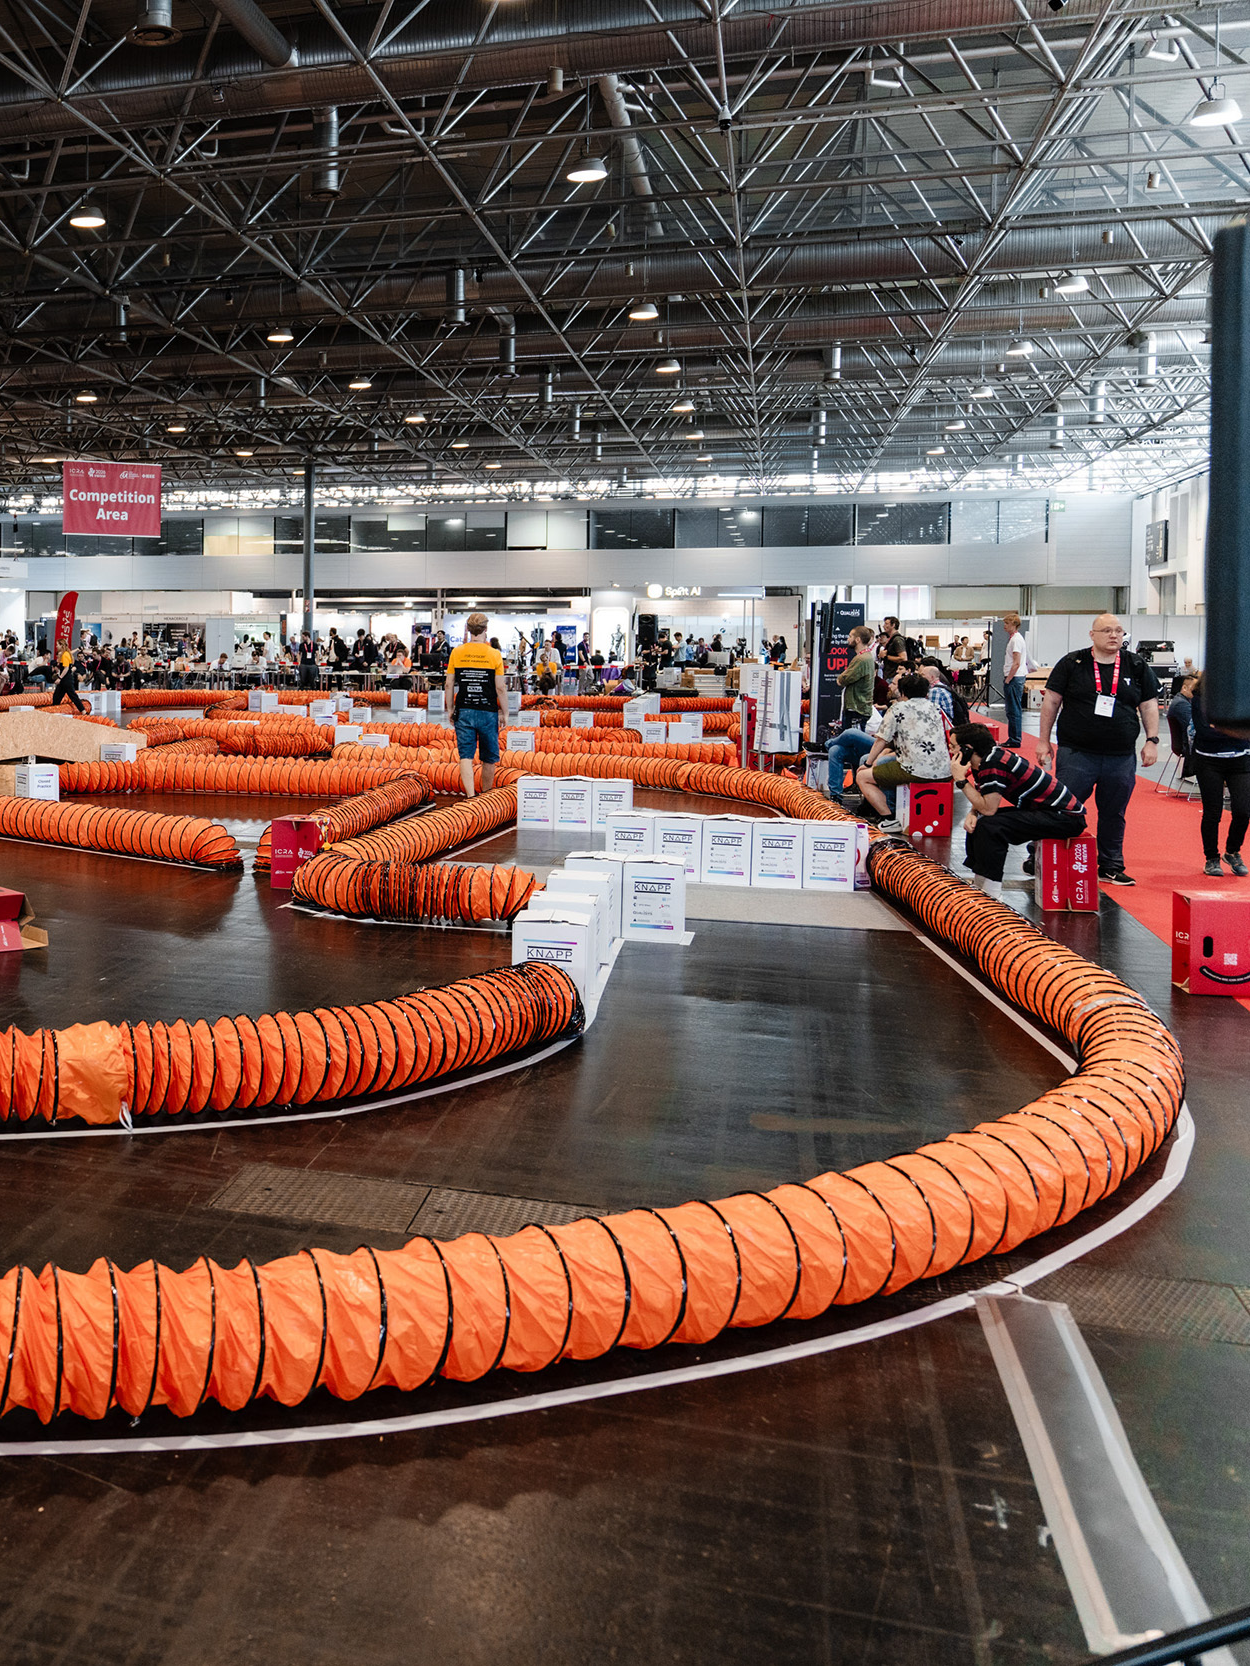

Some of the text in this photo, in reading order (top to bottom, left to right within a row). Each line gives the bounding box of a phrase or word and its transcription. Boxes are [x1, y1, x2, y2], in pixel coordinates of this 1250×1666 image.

[69, 488, 156, 506] Competition
[95, 507, 129, 521] Area
[690, 586, 701, 596] AI
[827, 658, 849, 671] UP!
[614, 831, 644, 840] KNAPP
[662, 834, 693, 842] KNAPP
[711, 836, 743, 844] KNAPP
[1076, 880, 1084, 903] ICRA
[527, 948, 573, 959] KNAPP
